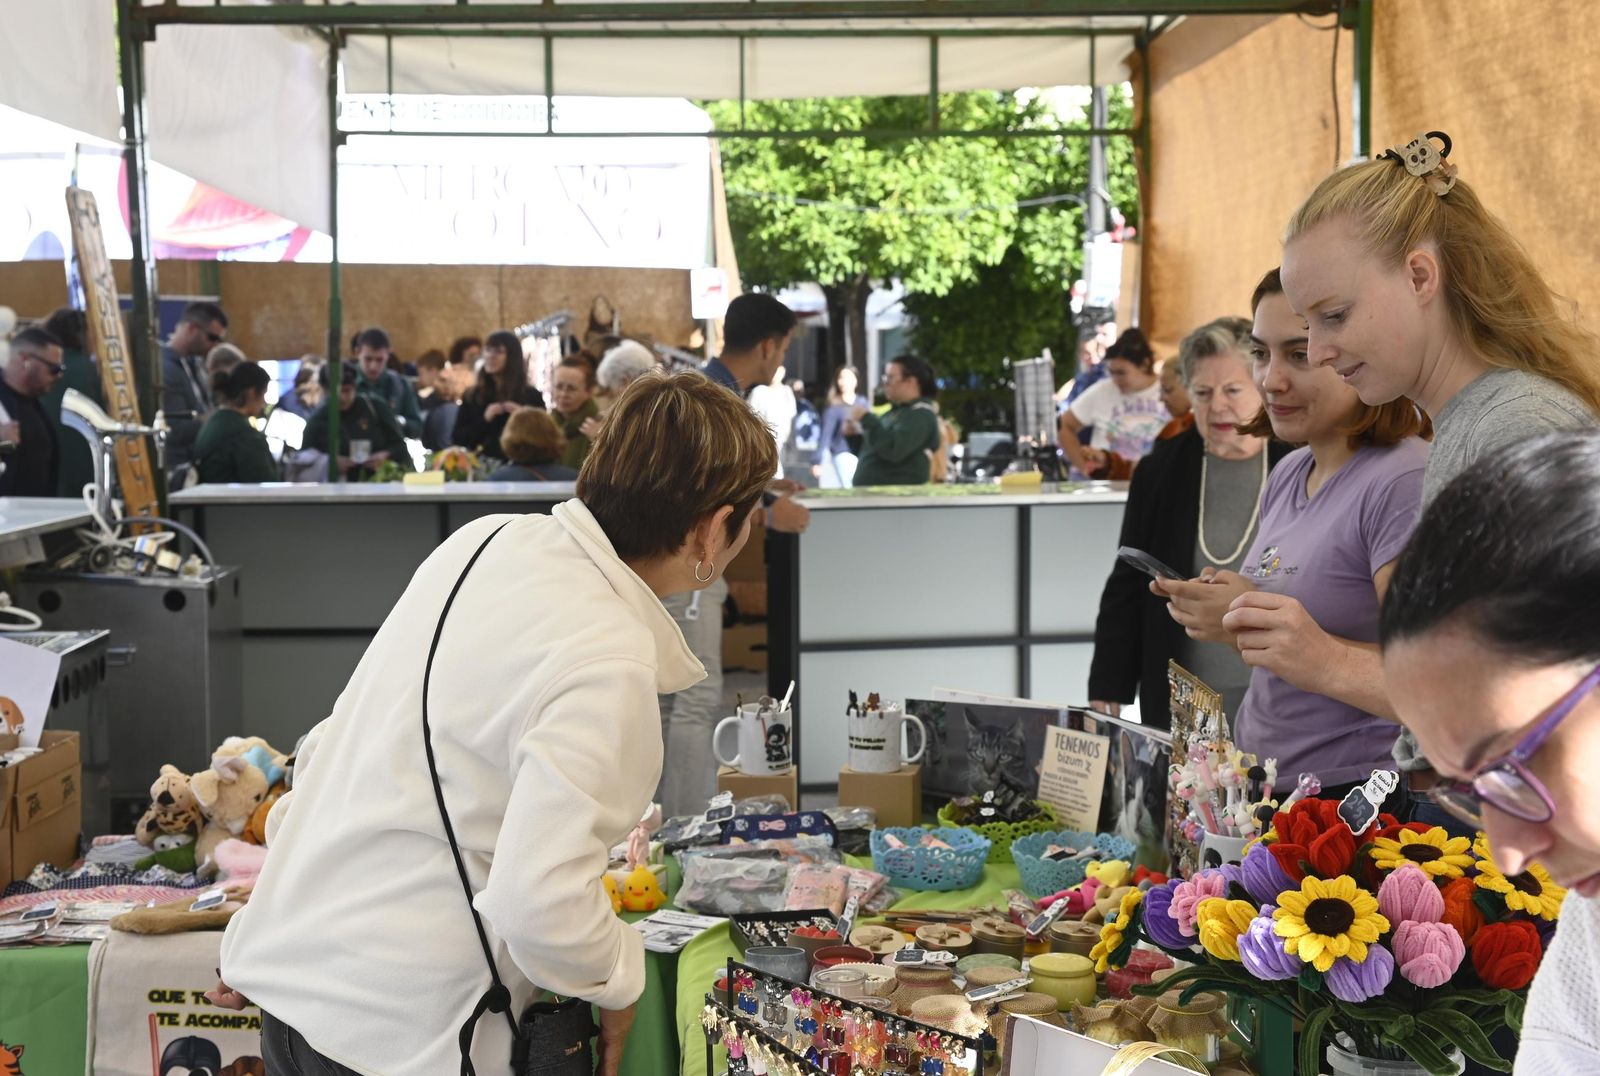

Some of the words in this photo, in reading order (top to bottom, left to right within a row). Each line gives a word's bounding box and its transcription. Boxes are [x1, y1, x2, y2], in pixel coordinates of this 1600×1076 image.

[1055, 733, 1101, 759] TENEMOS
[1057, 751, 1084, 768] bizum
[148, 989, 185, 1004] QUE
[156, 1012, 179, 1026] TE
[185, 1013, 263, 1030] ACOMPA
